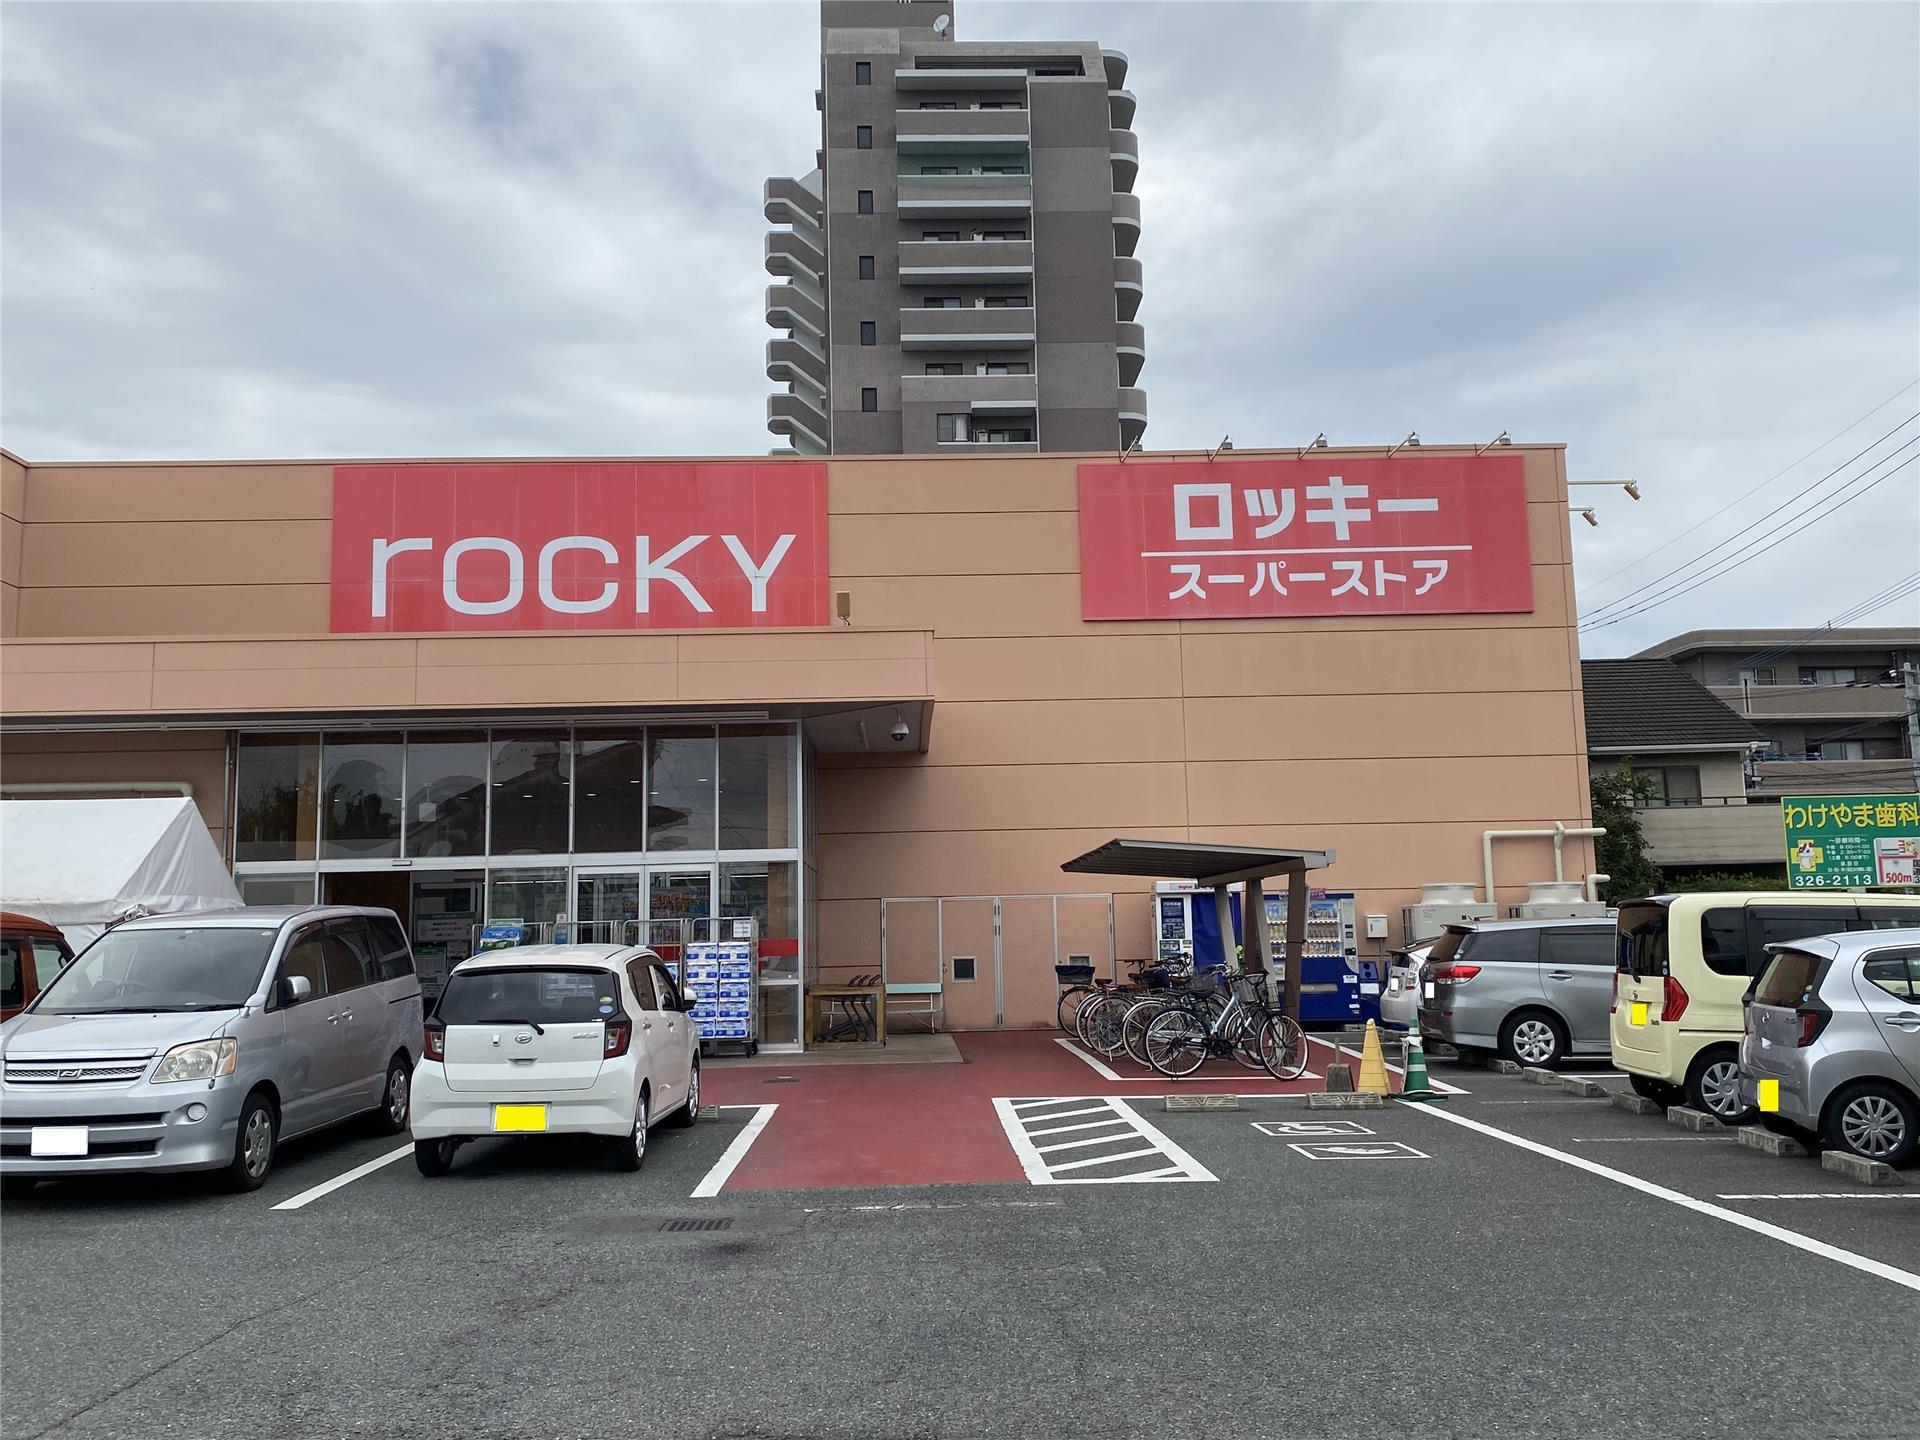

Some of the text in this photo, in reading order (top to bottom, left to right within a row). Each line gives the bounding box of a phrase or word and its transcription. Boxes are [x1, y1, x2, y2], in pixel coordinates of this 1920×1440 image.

[1173, 476, 1439, 541] ロッキー
[1169, 559, 1448, 600] スーパーストア
[1785, 802, 1920, 829] わけやま歯科
[1795, 875, 1872, 886] 326-2113
[1886, 873, 1912, 883] 500m
